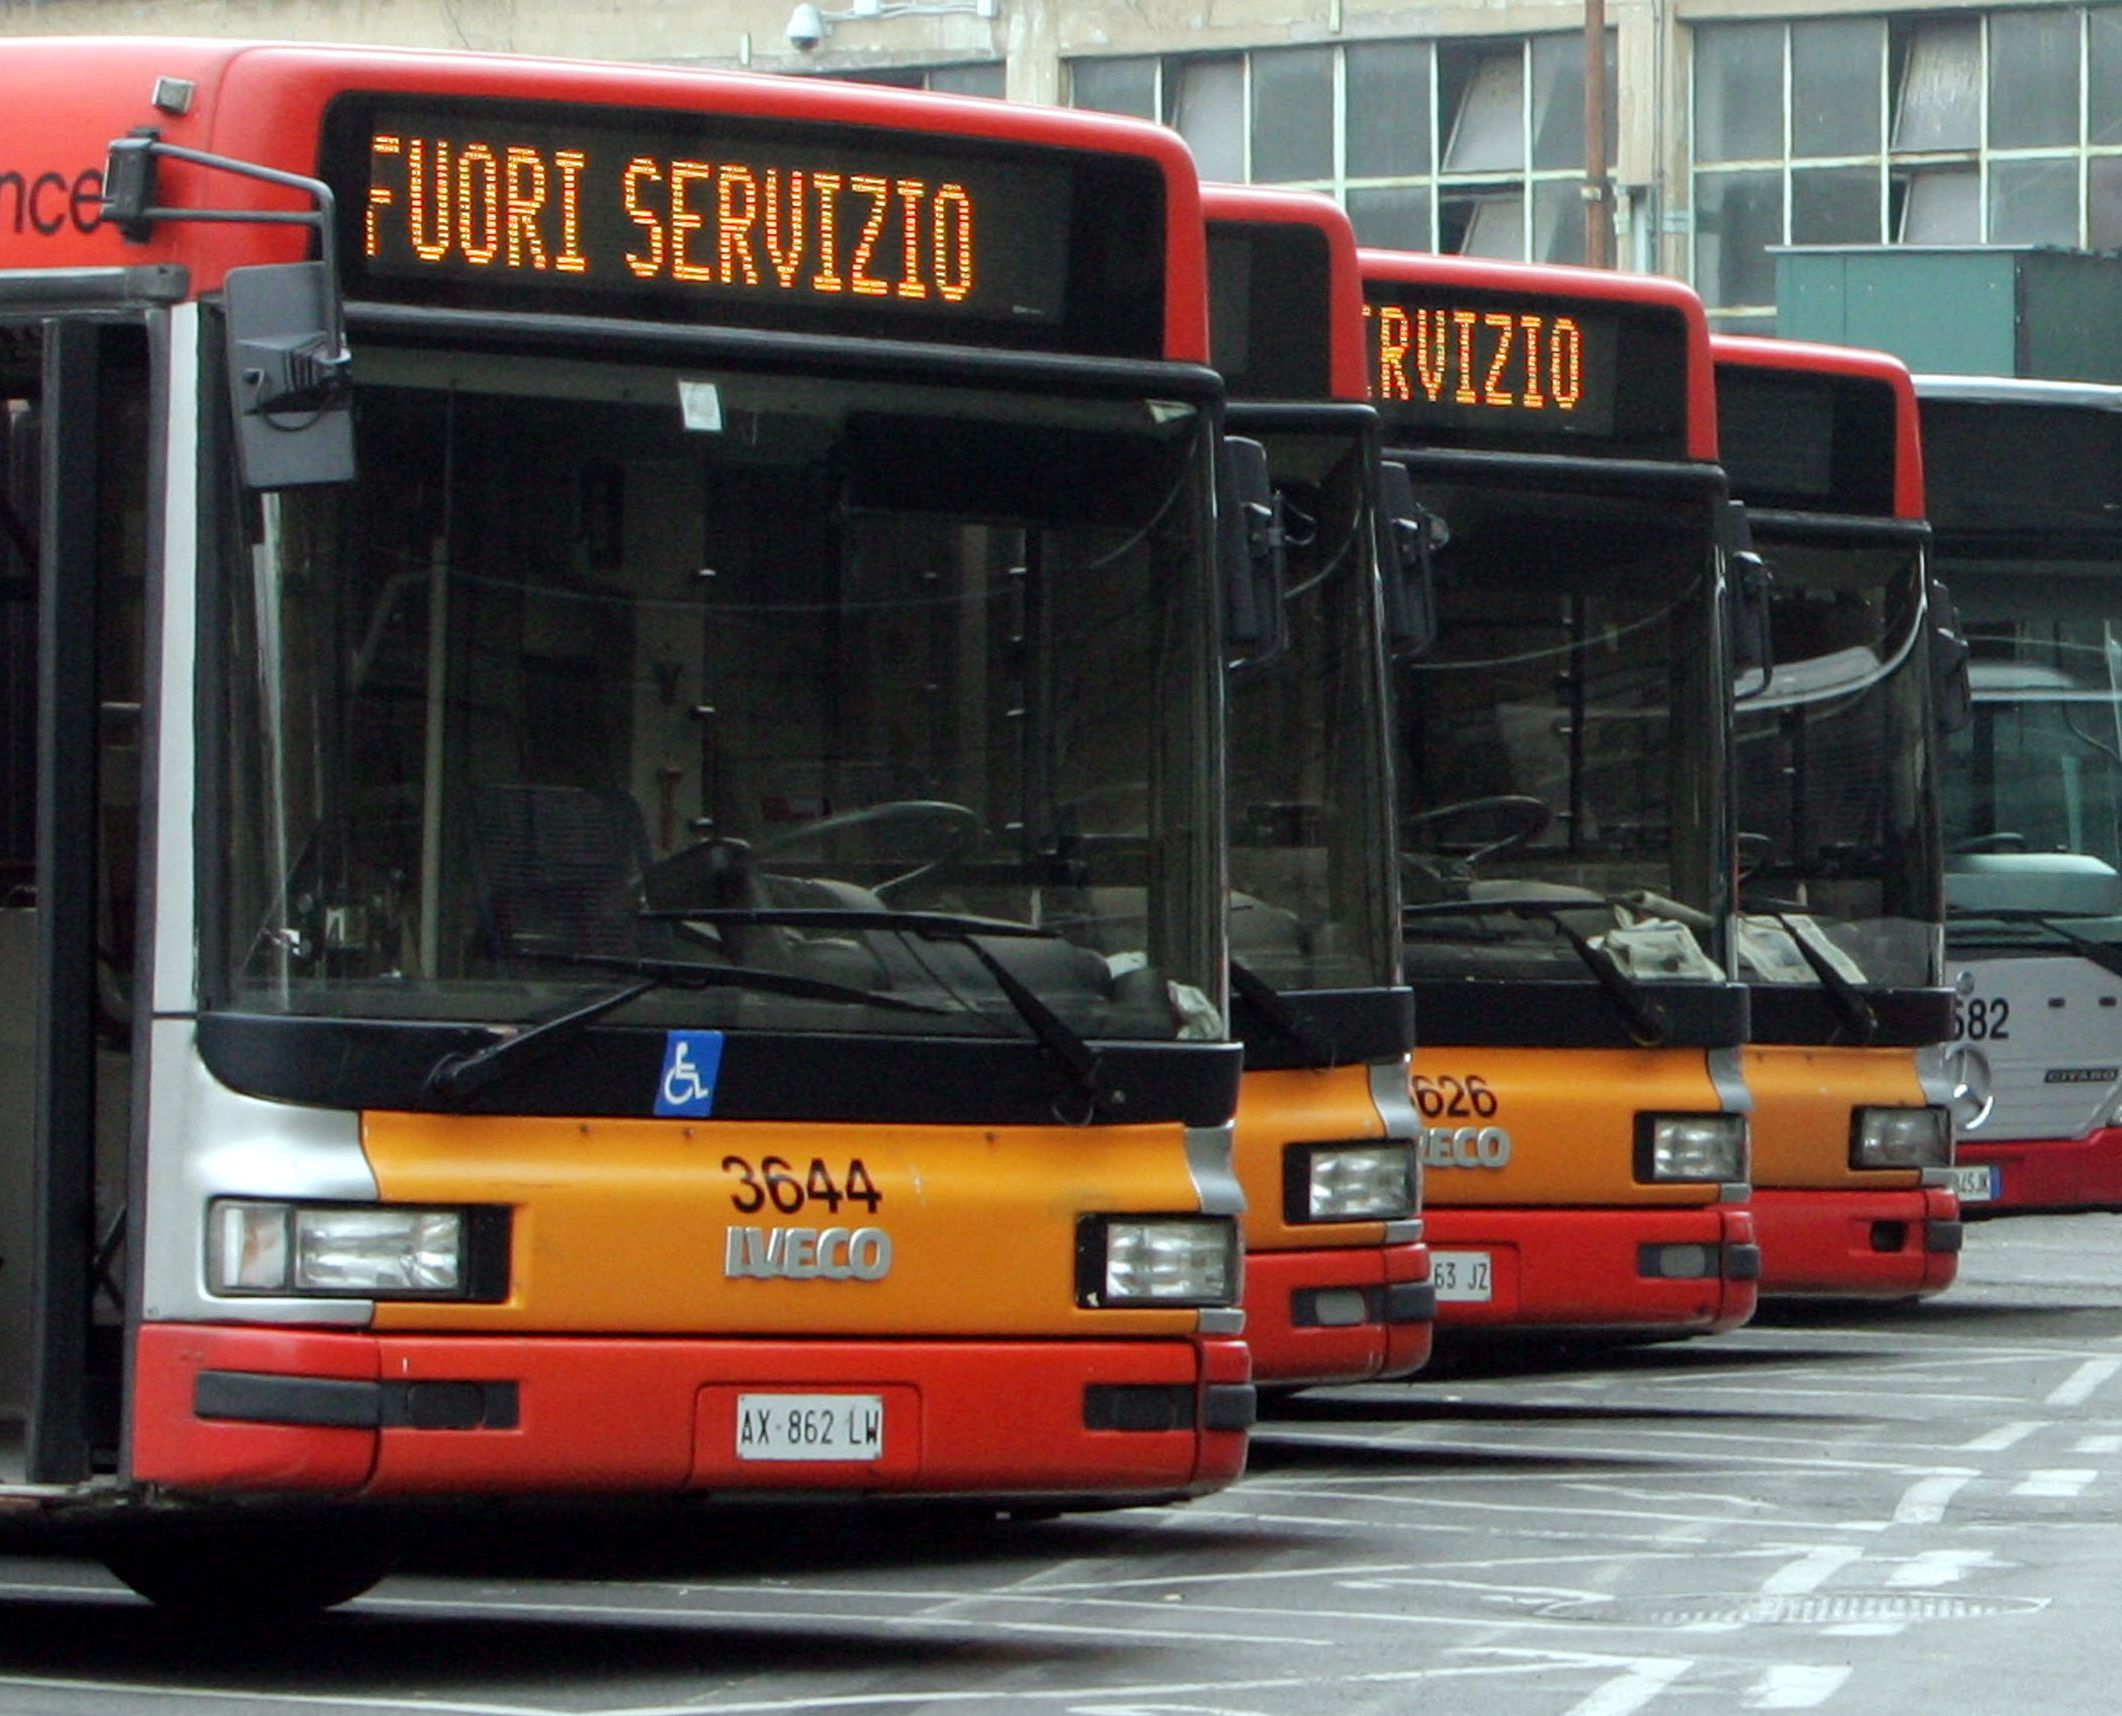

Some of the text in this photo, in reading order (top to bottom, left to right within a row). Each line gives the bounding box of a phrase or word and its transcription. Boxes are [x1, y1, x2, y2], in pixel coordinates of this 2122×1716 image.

[366, 134, 972, 302] FUORI SERVIZIO
[1362, 303, 1583, 410] RVIZIO
[721, 1155, 883, 1214] 3644
[724, 1225, 893, 1281] IVECO
[1467, 1262, 1489, 1290] JZ
[741, 1408, 879, 1445] AX 862 LW
